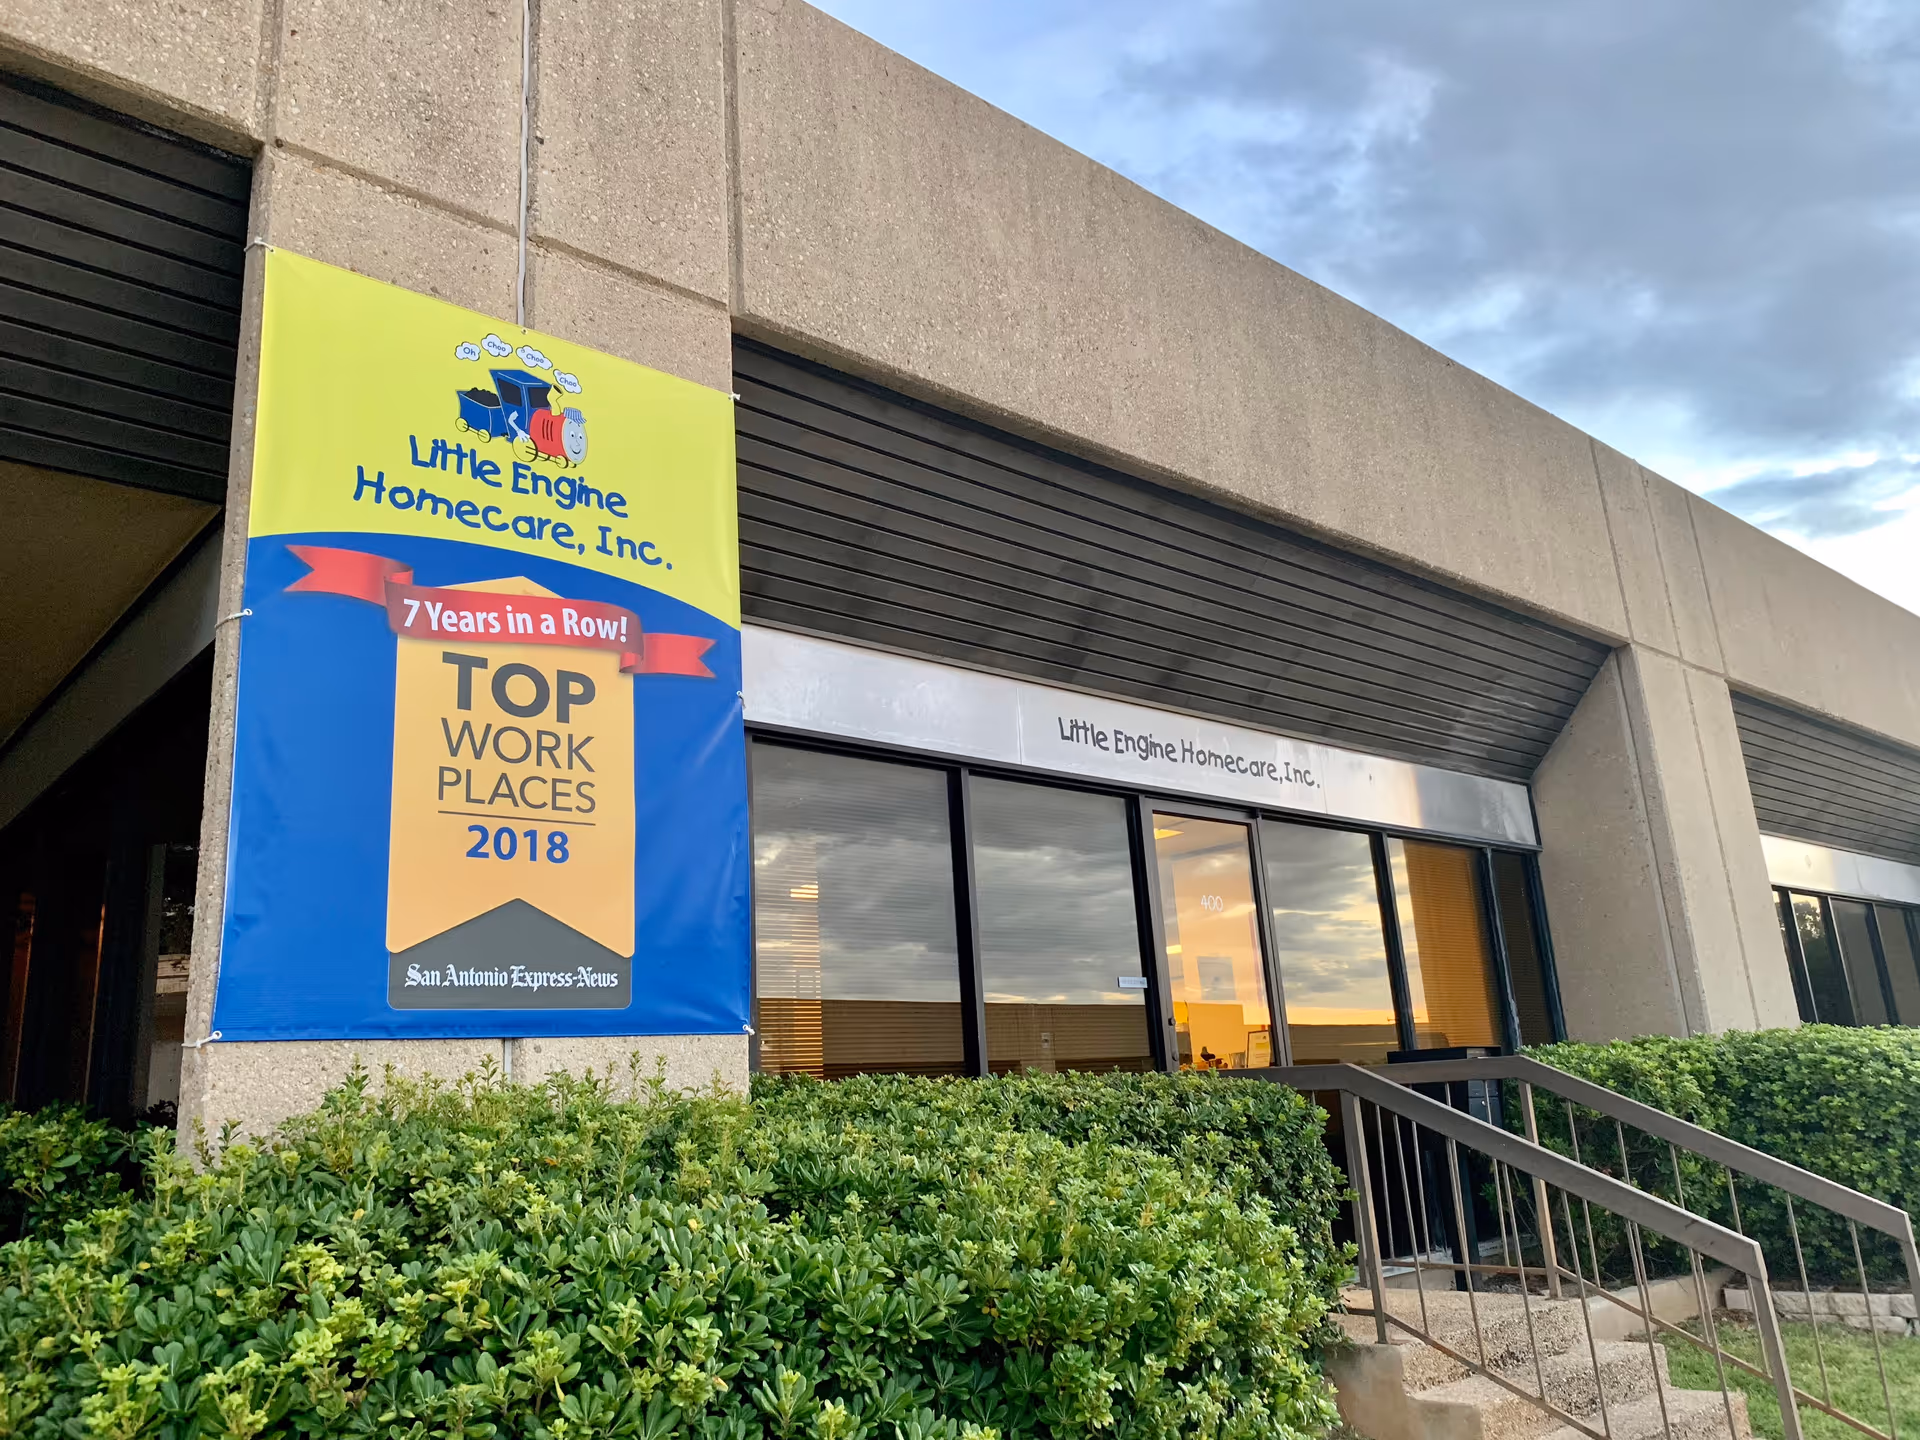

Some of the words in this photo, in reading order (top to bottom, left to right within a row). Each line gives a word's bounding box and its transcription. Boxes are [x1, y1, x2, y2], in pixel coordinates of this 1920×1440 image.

[463, 347, 476, 357] Oh
[487, 341, 506, 352] Choo
[526, 353, 544, 364] Choo
[409, 435, 502, 488] Little
[511, 461, 628, 519] Engine
[353, 465, 585, 555] Homecare,
[596, 525, 673, 570] Inc.
[403, 598, 420, 628] 7
[424, 600, 501, 633] Years
[505, 605, 534, 634] in
[540, 616, 556, 635] a
[562, 608, 628, 643] Row!
[442, 651, 596, 724] TOP
[440, 717, 595, 772] WORK
[1058, 717, 1109, 751] Little
[1113, 729, 1178, 763] Engine
[1181, 739, 1283, 784] Homecare,
[1284, 761, 1321, 789] Inc.
[438, 765, 596, 814] PLACES
[466, 824, 570, 864] 2018
[1200, 895, 1223, 912] 400
[405, 963, 441, 988] San
[441, 963, 508, 988] Antonio
[509, 965, 619, 992] Express-News
